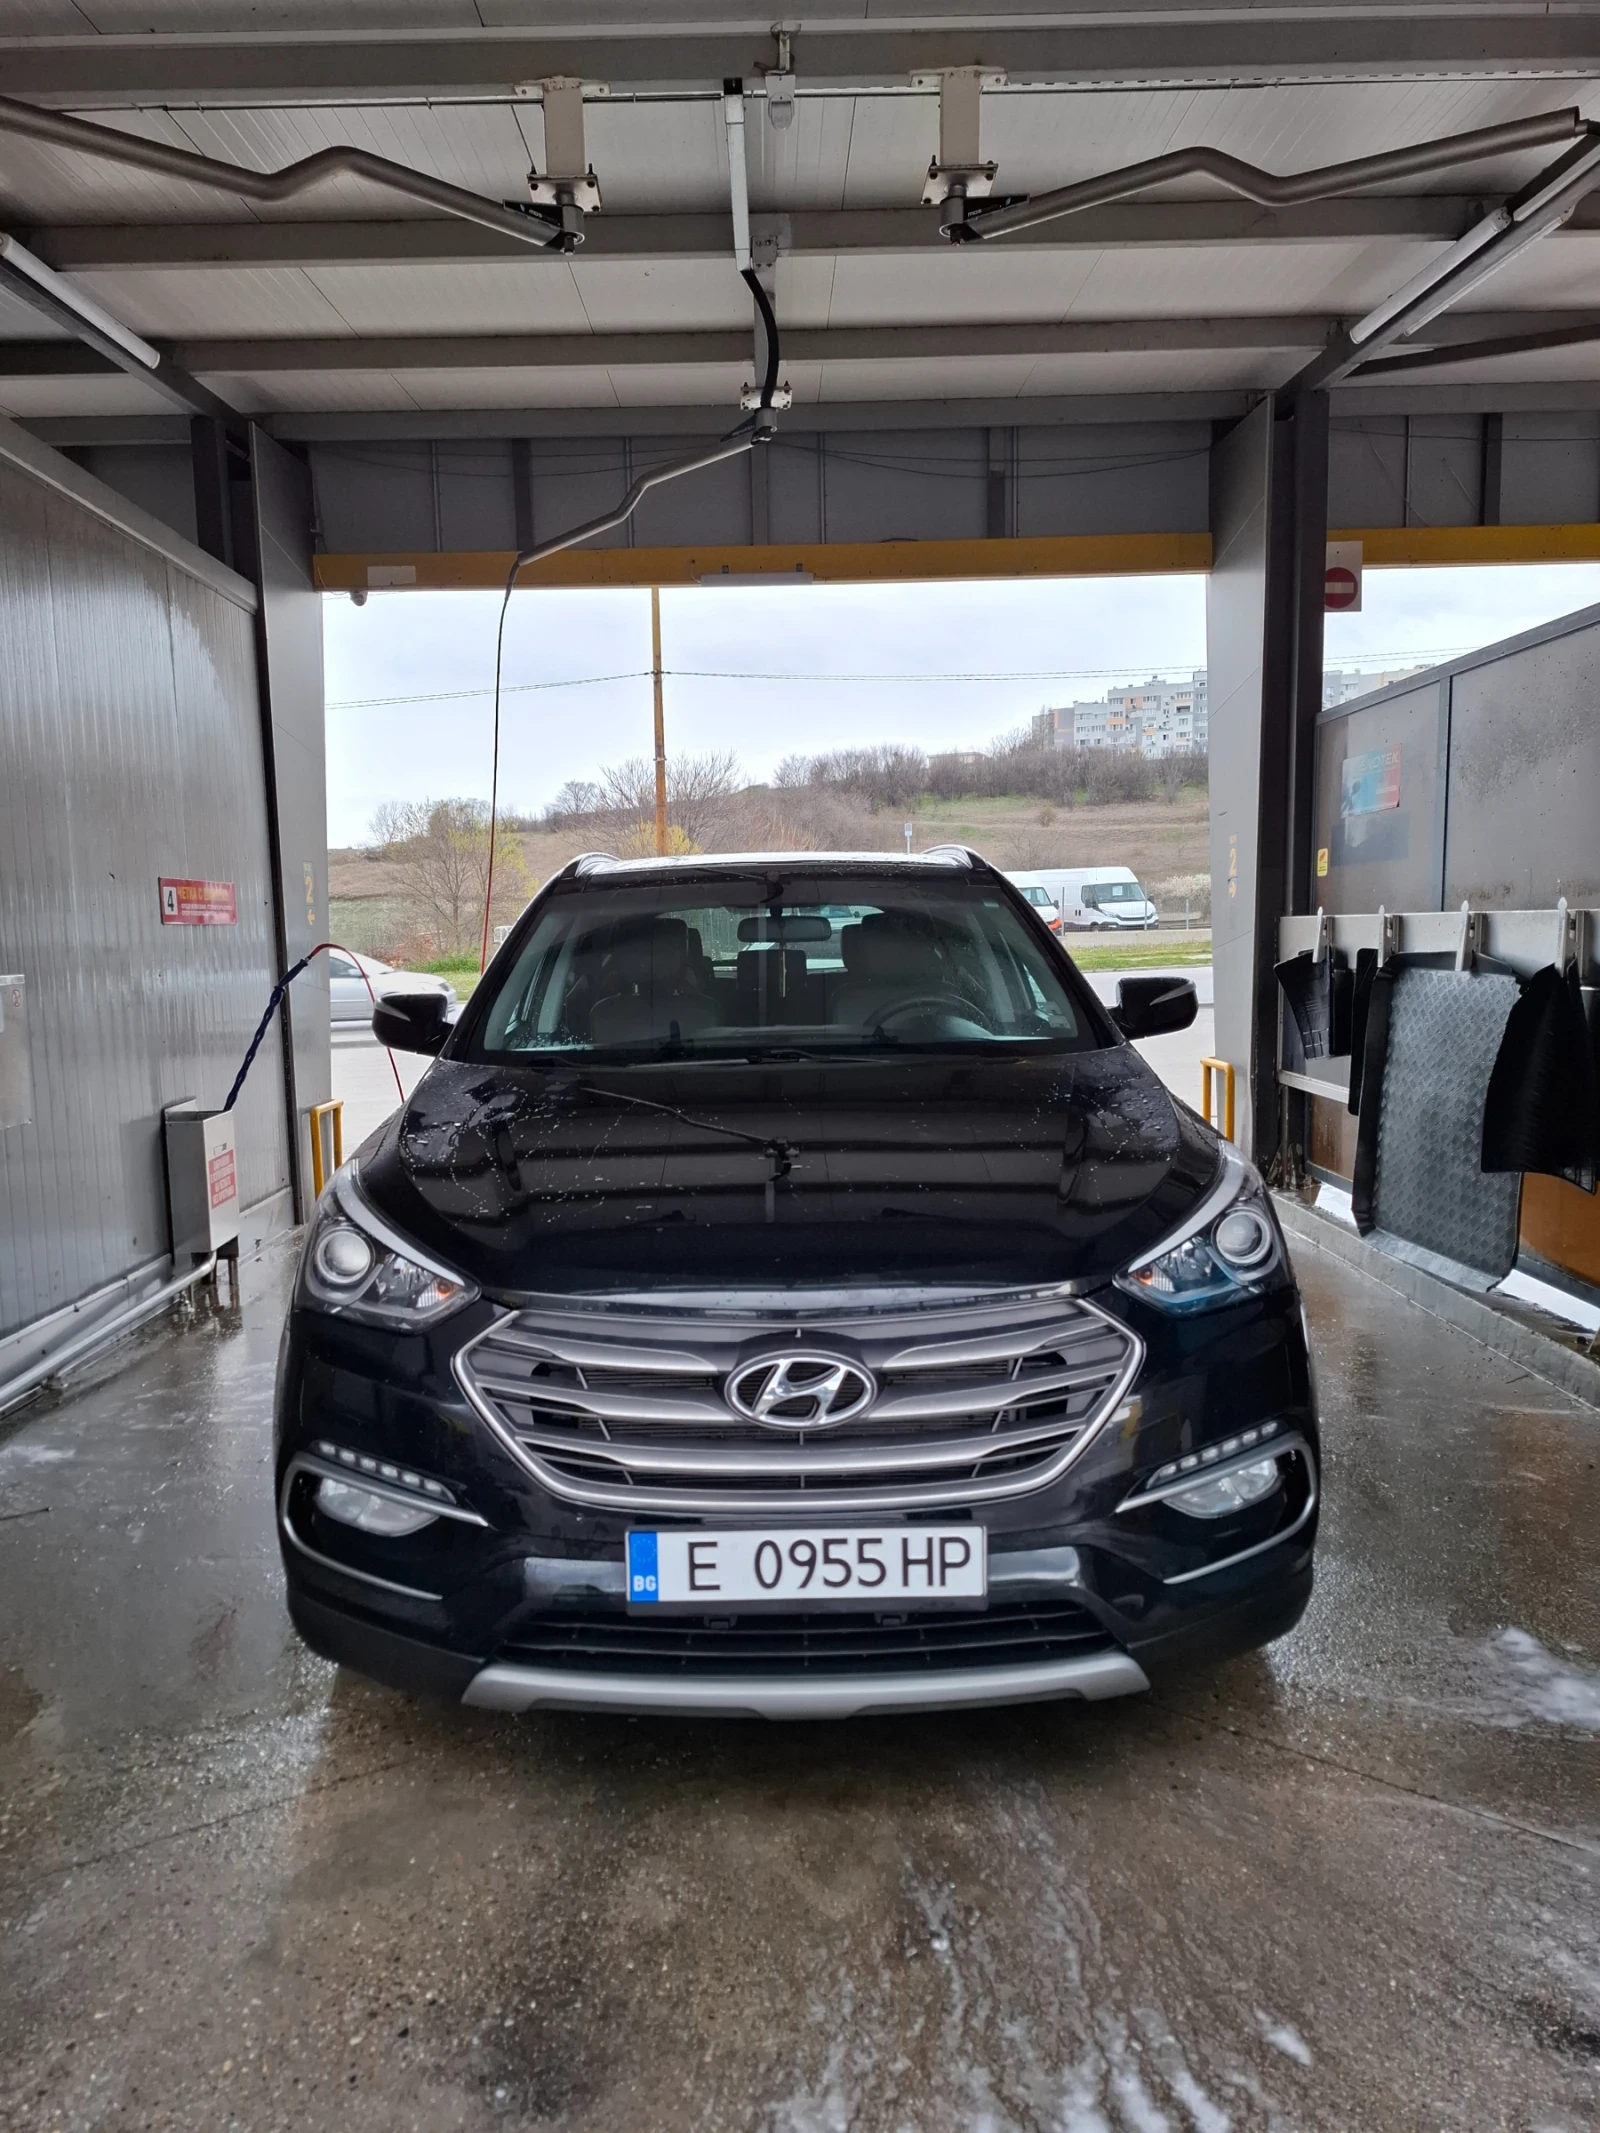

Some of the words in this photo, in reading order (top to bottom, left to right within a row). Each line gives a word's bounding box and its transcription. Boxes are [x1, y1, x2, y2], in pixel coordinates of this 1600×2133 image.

[1355, 751, 1400, 771] ENOTEK
[1230, 848, 1237, 876] 2
[167, 890, 175, 912] 4
[305, 876, 314, 904] 2
[687, 1541, 721, 1591] E
[754, 1538, 887, 1590] 0955
[901, 1536, 971, 1588] HP
[633, 1575, 657, 1592] BG
